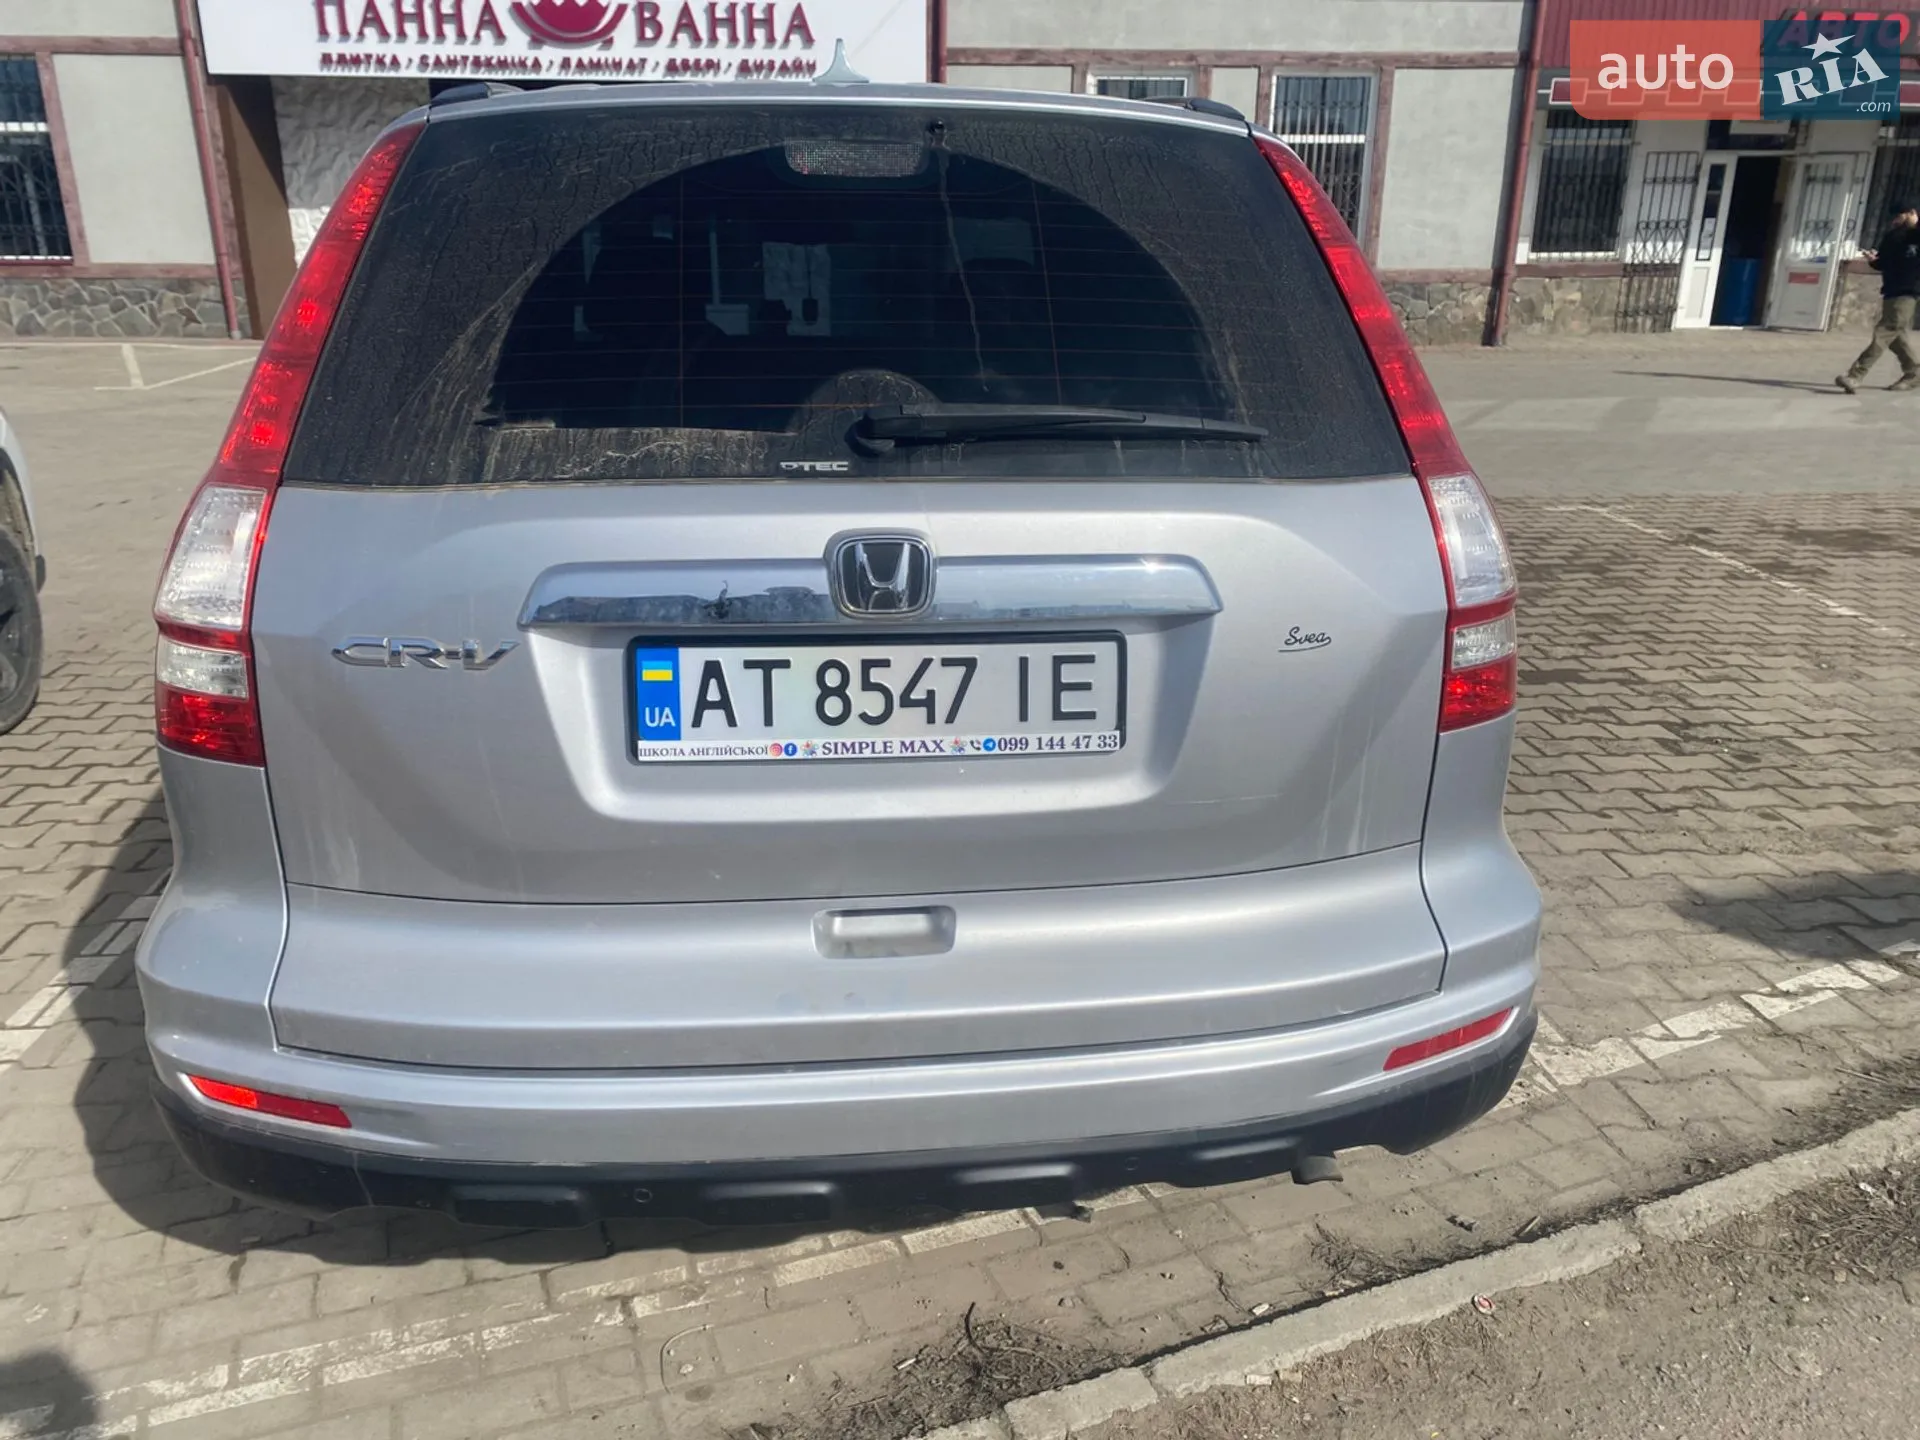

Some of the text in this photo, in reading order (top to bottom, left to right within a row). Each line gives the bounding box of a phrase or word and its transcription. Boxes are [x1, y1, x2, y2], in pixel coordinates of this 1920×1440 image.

[315, 0, 816, 47] ПАННА ВАННА
[320, 52, 817, 79] ПЛИТКА САНТЕХНІКА ЛАМІНАТ ДВЕРІ ДИЗАЙН
[1283, 626, 1332, 646] Svea
[331, 636, 520, 670] CR-V
[691, 653, 1097, 728] AT 8547 IE
[645, 706, 676, 728] UA
[639, 744, 769, 758] ШКОЛА АНГЛІЙСЬКОЇ
[822, 739, 946, 755] SIMPLE MAX
[998, 734, 1118, 751] 099 144 47 33
